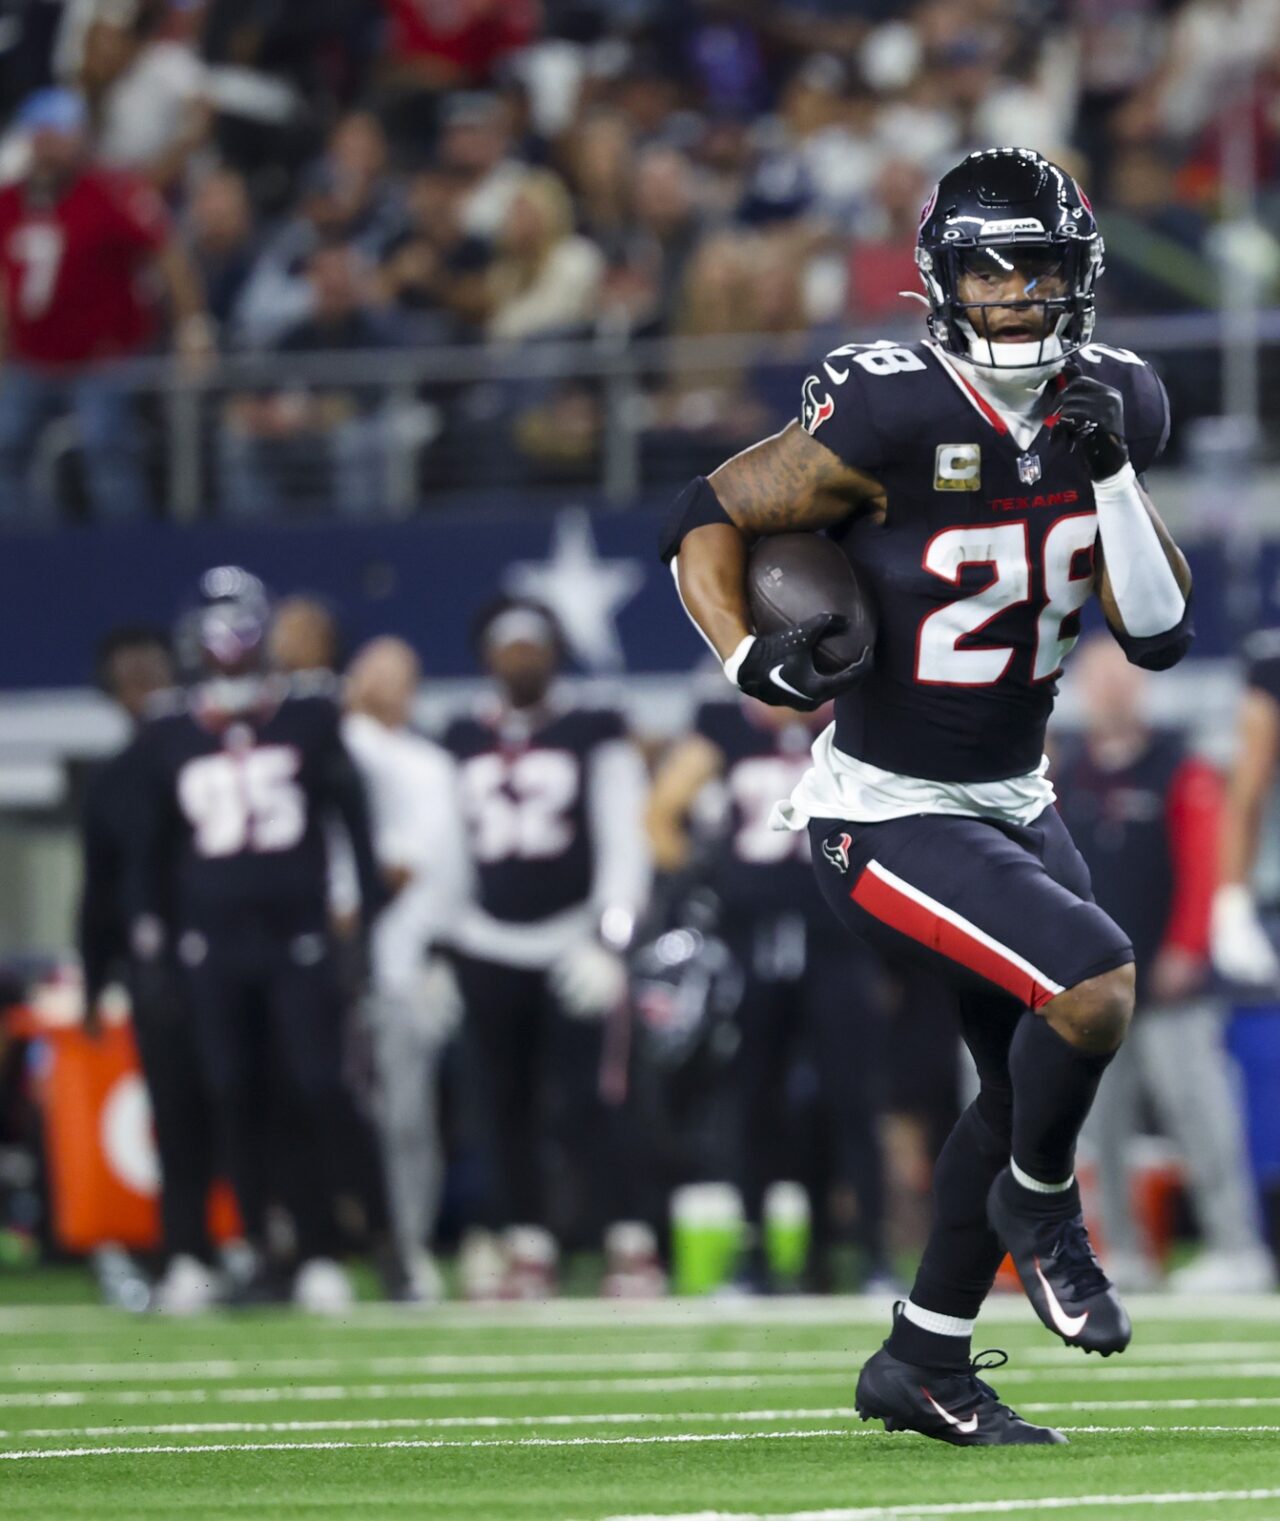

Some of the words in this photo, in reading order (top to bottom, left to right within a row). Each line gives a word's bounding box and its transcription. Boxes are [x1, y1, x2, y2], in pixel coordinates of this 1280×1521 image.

[940, 447, 977, 480] C
[992, 490, 1079, 512] TEXANS
[914, 511, 1098, 686] 28
[178, 744, 308, 859] 95
